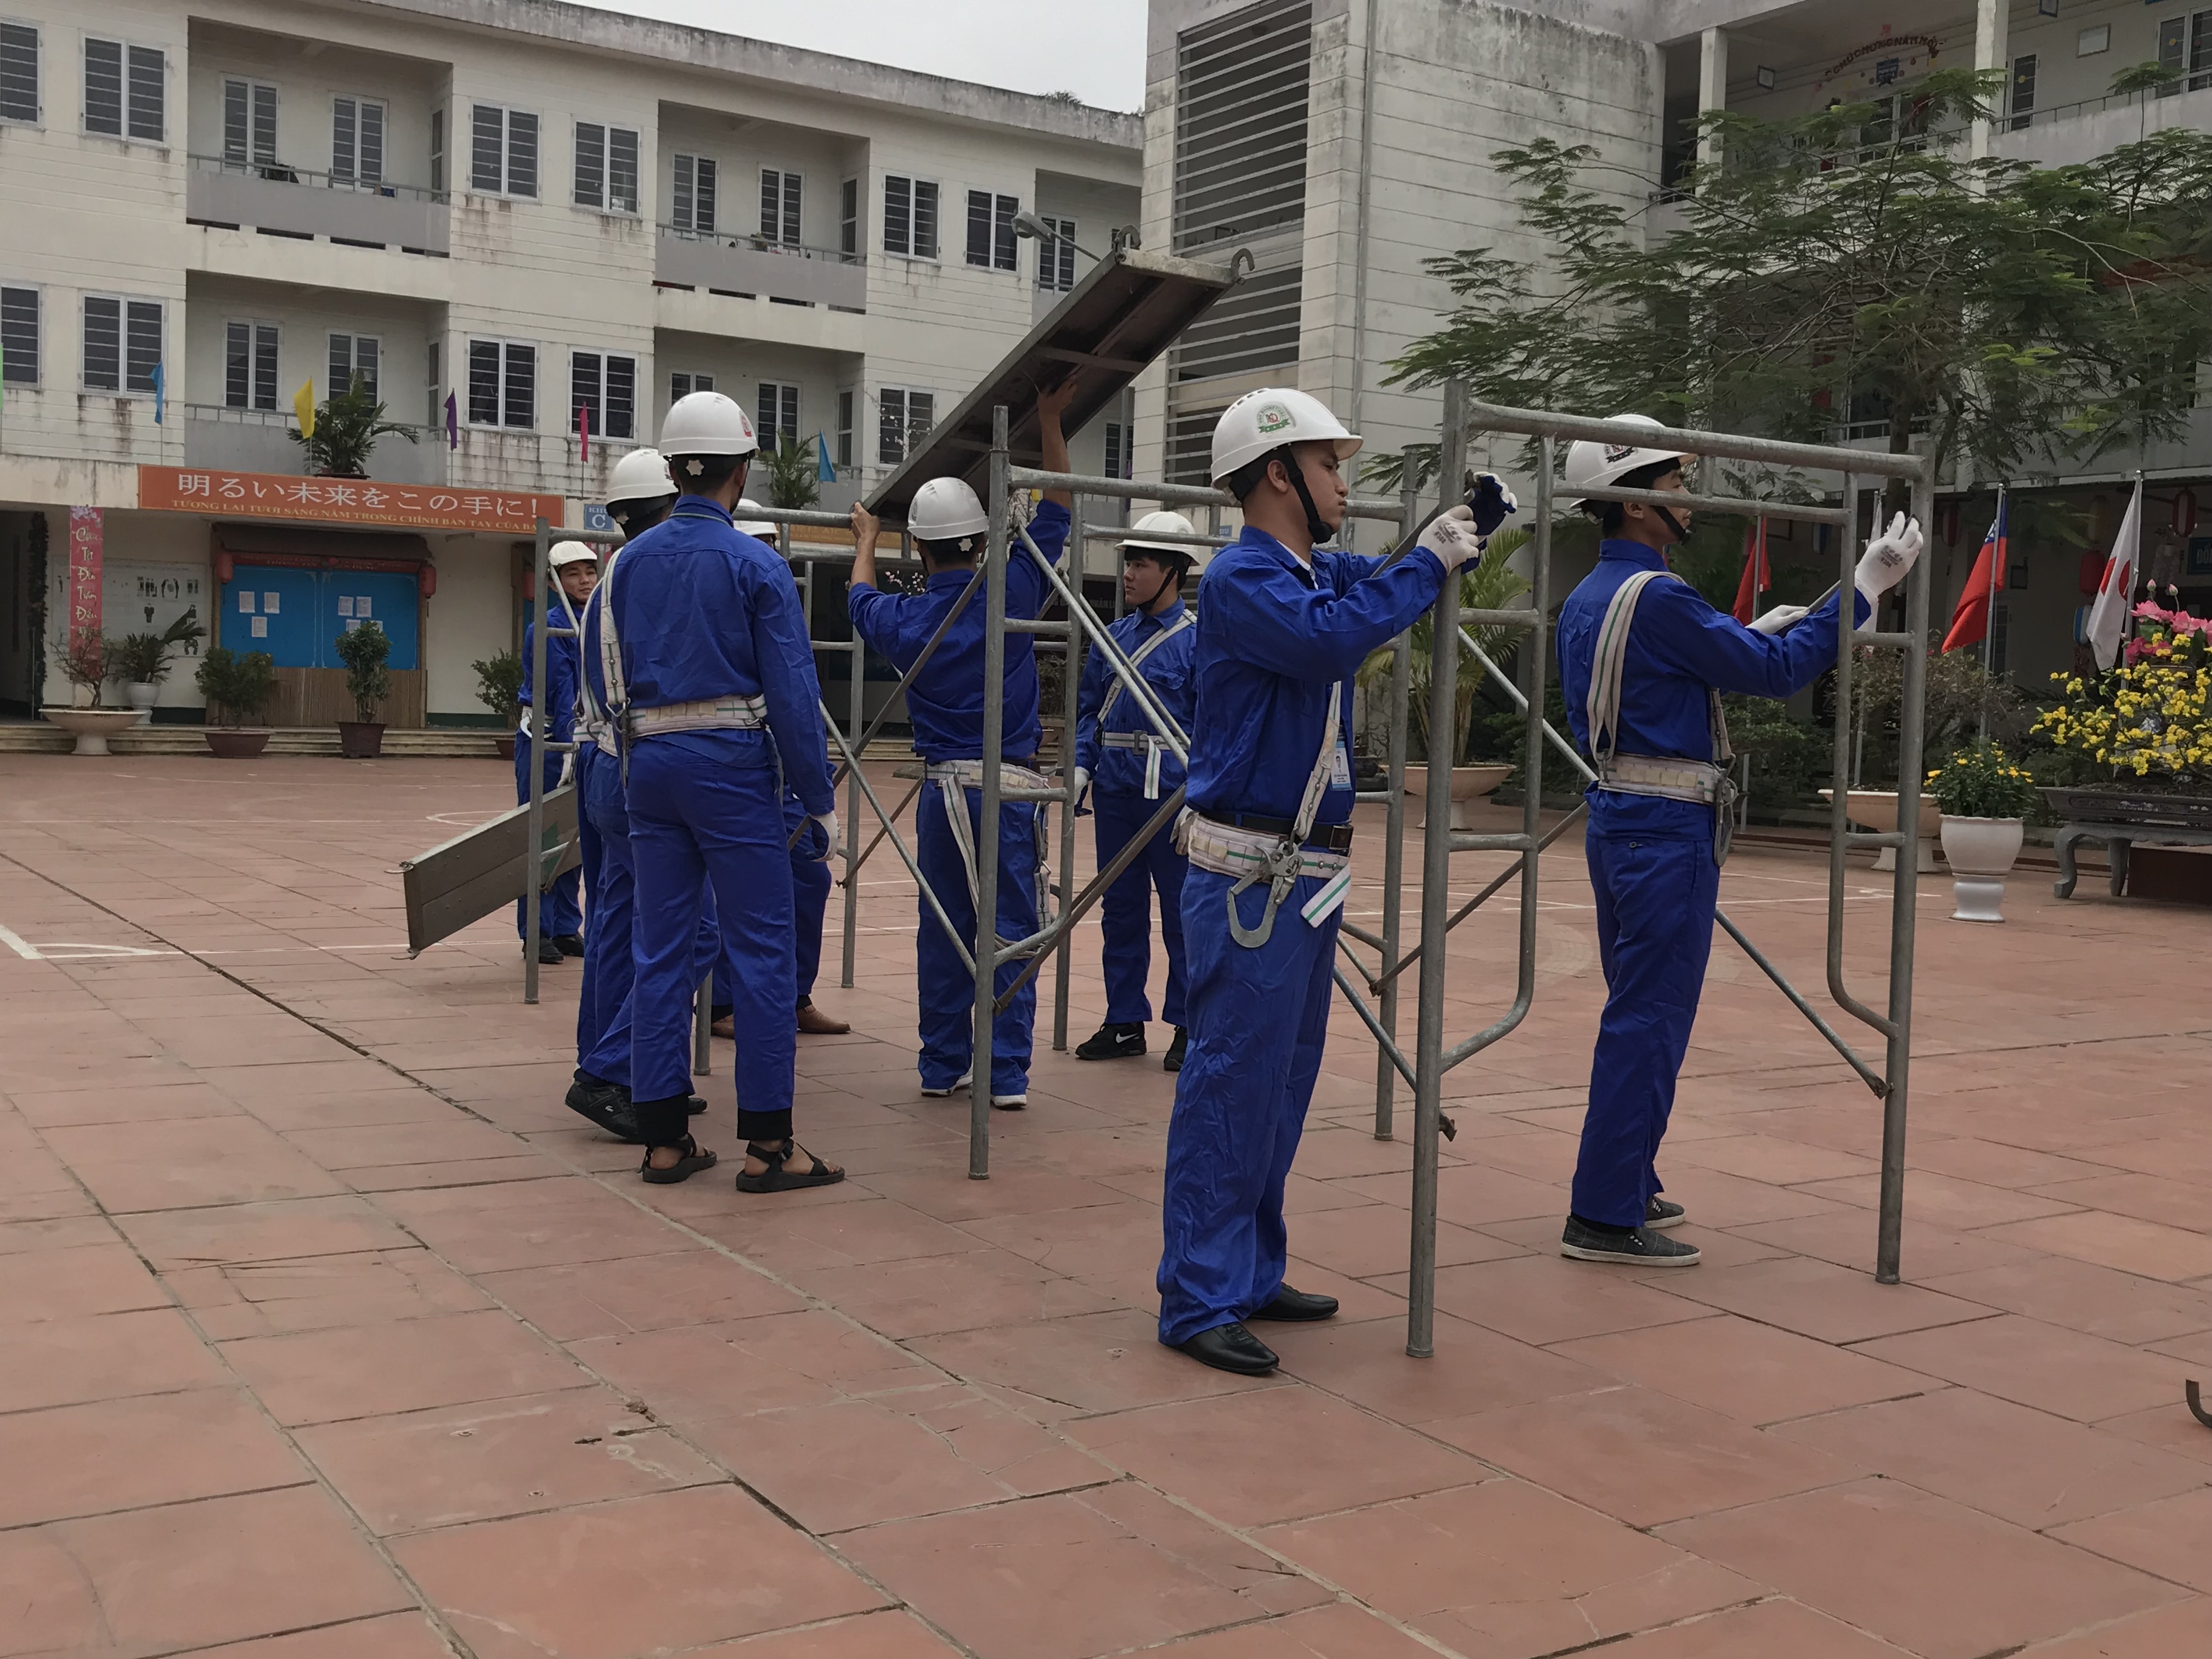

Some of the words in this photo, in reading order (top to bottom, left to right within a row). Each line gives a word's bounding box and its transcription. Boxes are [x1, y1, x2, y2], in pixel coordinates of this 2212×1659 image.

[172, 500, 219, 510] TƯƠNG
[223, 502, 245, 512] LAI
[284, 506, 318, 517] SÁNG
[352, 512, 397, 522] TRONG
[400, 514, 439, 524] CHÍNH
[442, 516, 466, 527] BÀN
[470, 520, 492, 528] TAY
[495, 519, 520, 530] CỦA
[592, 514, 606, 528] C
